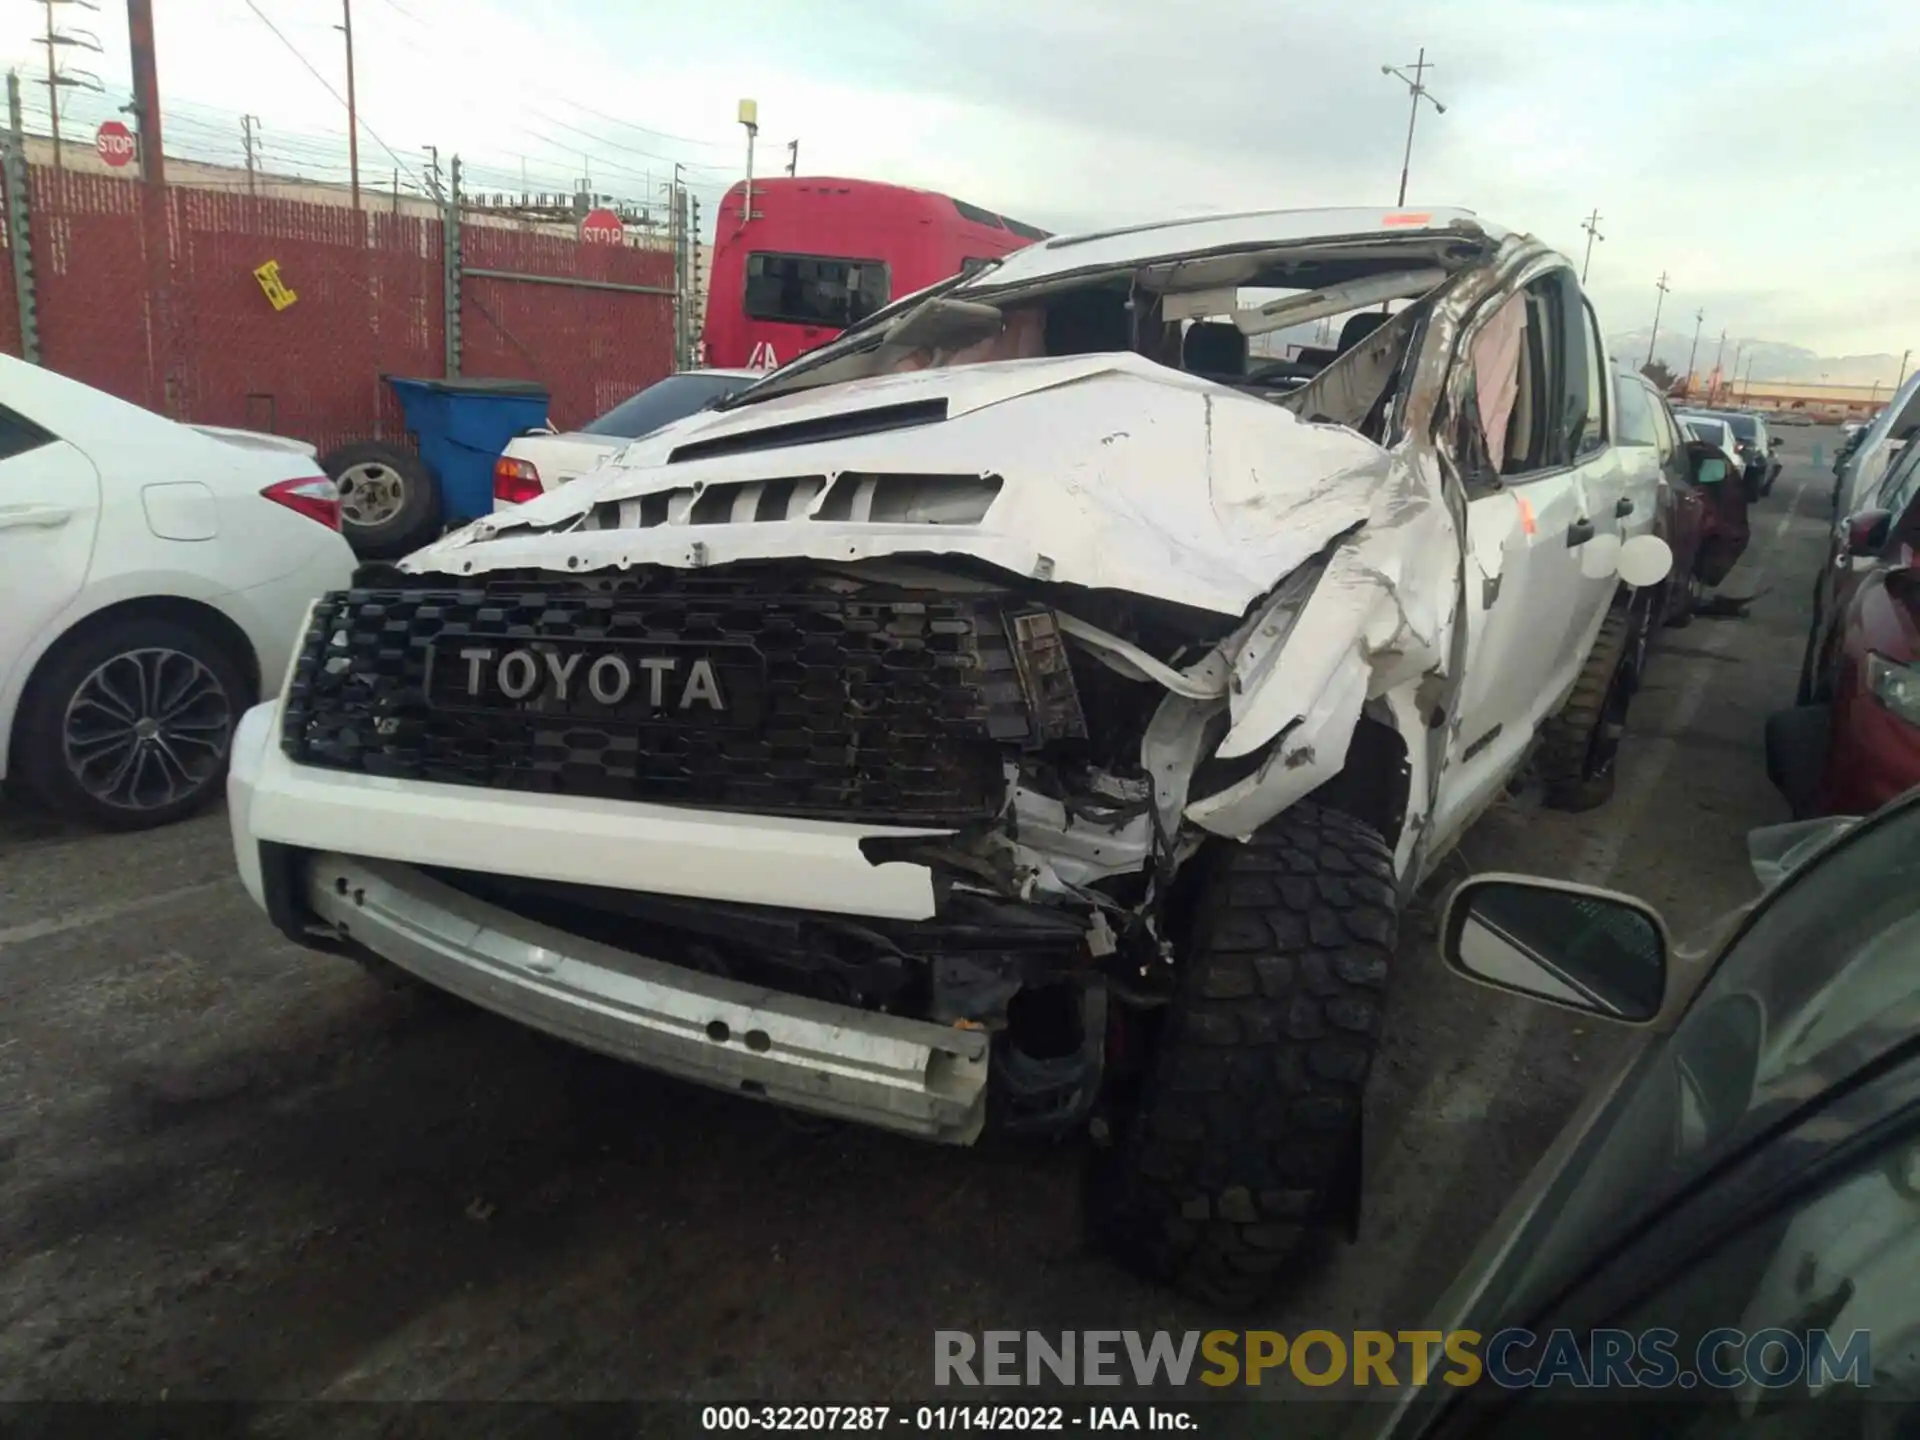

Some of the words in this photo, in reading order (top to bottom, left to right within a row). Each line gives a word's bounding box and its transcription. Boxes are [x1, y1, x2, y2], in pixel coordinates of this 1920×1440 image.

[98, 134, 133, 154] STOP
[584, 226, 622, 245] STOP
[460, 648, 724, 710] TOYOTA
